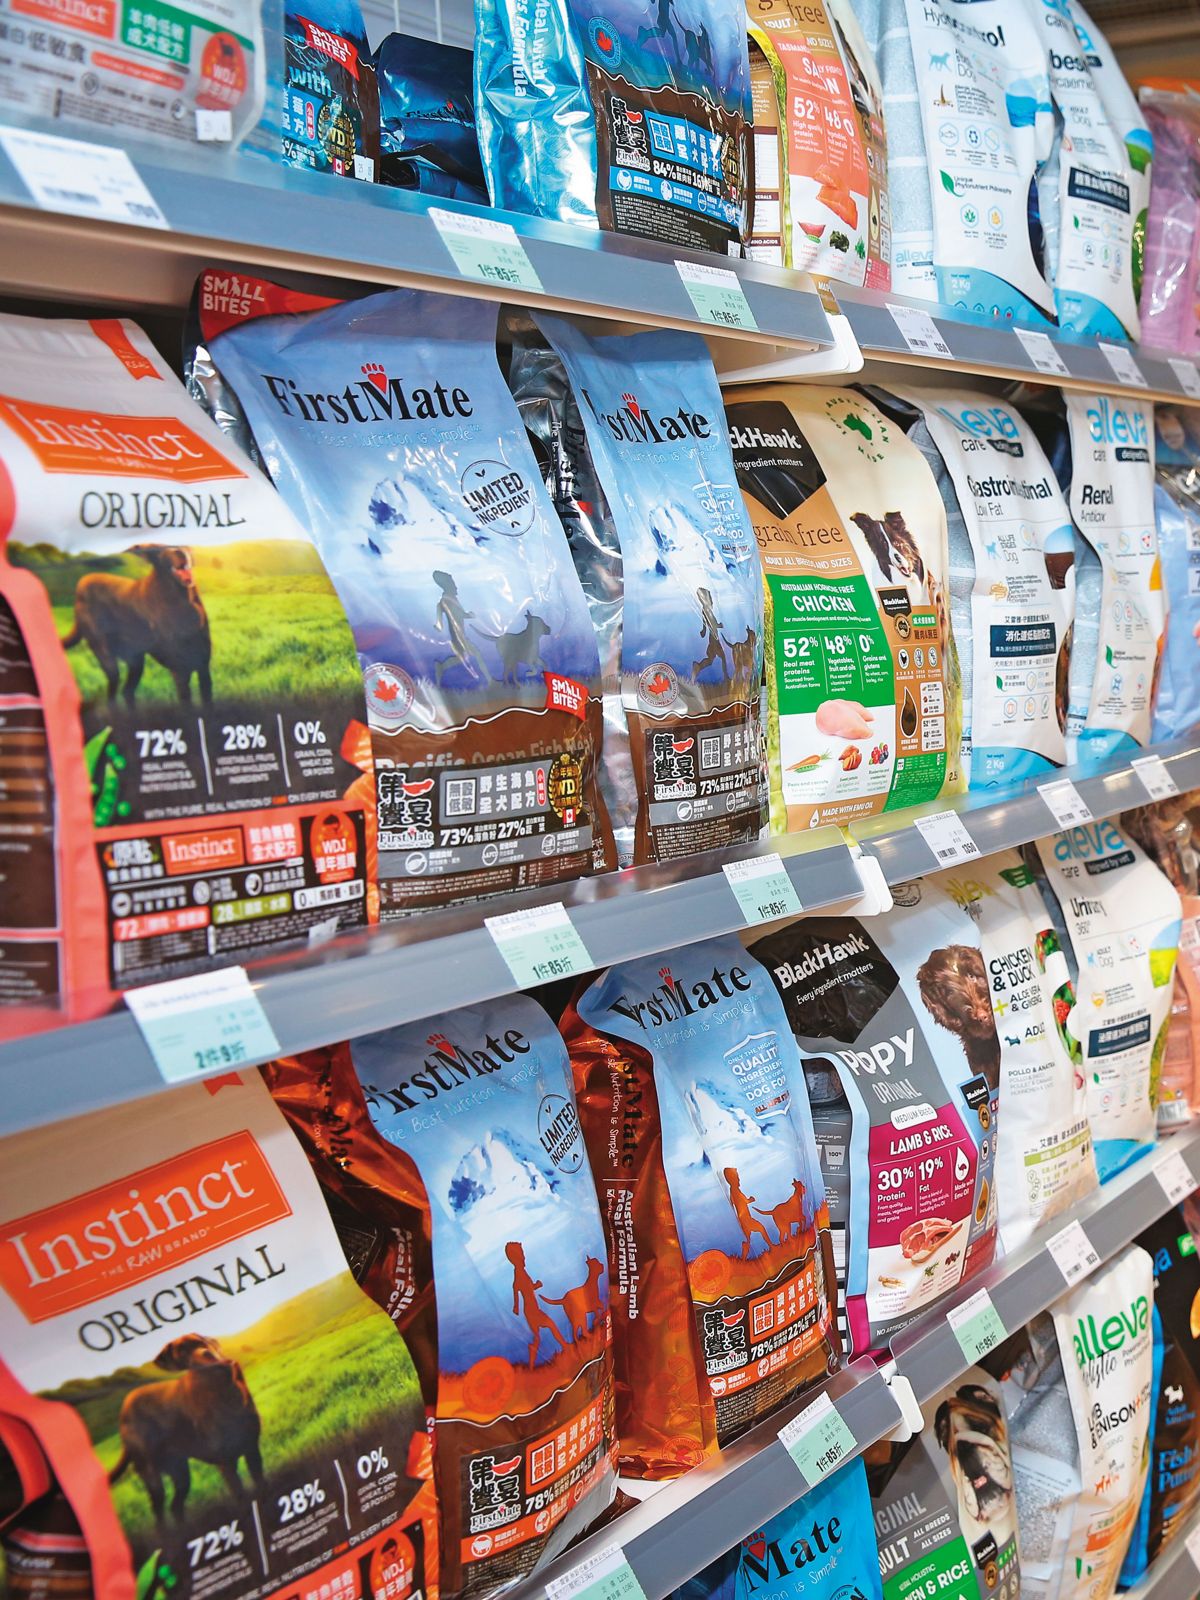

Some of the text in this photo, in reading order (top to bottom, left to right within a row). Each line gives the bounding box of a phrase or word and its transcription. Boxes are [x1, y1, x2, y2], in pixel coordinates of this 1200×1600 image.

[308, 24, 352, 57] SMALL
[312, 33, 348, 63] BITES
[288, 65, 333, 98] with
[652, 160, 676, 179] 84%
[203, 274, 266, 303] SMALL
[203, 293, 251, 317] BITES
[261, 374, 474, 424] FirstMate
[8, 404, 204, 462] Instinct
[731, 426, 802, 450] ckHawk
[962, 438, 987, 452] care
[736, 458, 777, 471] ingredient
[463, 472, 525, 514] LIMITED
[1081, 484, 1114, 506] Renal
[79, 491, 247, 530] ORIGINAL
[476, 489, 534, 527] INGREDIENT
[989, 501, 1003, 516] Fat
[753, 522, 844, 548] grain free
[765, 556, 853, 568] ADULT SIZES
[781, 583, 856, 595] AUSTRALIAN FREE
[791, 594, 856, 613] CHICKEN
[783, 634, 875, 658] 52% 48% 0%
[783, 659, 815, 668] Real meat
[783, 667, 810, 677] proteins
[828, 657, 855, 666] Vegetables,
[552, 678, 583, 700] SMALL
[553, 692, 578, 711] BITES
[136, 720, 327, 758] 72% 28% 0%
[993, 758, 1005, 770] Kg
[655, 782, 696, 797] FirstMate
[700, 779, 720, 797] 73%
[821, 804, 854, 818] MADE WITH
[379, 829, 433, 844] FirstMate
[440, 827, 474, 847] 73%
[497, 819, 525, 840] 27%
[168, 834, 236, 863] Instinct
[321, 838, 347, 854] WDJ
[757, 899, 789, 919] 1件85折
[532, 956, 574, 980] 1件85折
[773, 933, 870, 990] BlackHawk
[989, 946, 1035, 976] CHICKEN
[1099, 955, 1115, 968] Dog
[796, 961, 874, 1006] Every ingredient matters
[992, 965, 1036, 993] & DUCK
[727, 1049, 757, 1064] ONLY THE
[1008, 1067, 1032, 1077] POLLO
[609, 1070, 622, 1125] Nutrition is
[745, 1083, 770, 1101] DOG
[411, 1085, 496, 1135] Best Nutrition
[755, 1104, 768, 1114] ALL
[894, 1111, 919, 1124] MEDIUM
[540, 1102, 576, 1154] LIMITED
[889, 1124, 954, 1156] LAMB & RICE
[877, 1156, 944, 1191] 30% 19%
[877, 1183, 930, 1203] Protein Fat
[954, 1182, 966, 1191] Made
[954, 1191, 964, 1200] Emu
[889, 1202, 904, 1211] quality
[892, 1205, 913, 1216] vegetables
[8, 1158, 256, 1288] Instinct
[887, 1215, 900, 1223] grains
[613, 1188, 629, 1295] Meal Formula
[101, 1228, 211, 1280] THE RAW BRAND
[623, 1188, 640, 1320] Australian Lamb
[79, 1244, 287, 1352] ORIGINAL
[787, 1319, 805, 1340] 22%
[1072, 1295, 1150, 1370] alleva
[706, 1351, 748, 1371] FirstMate
[750, 1339, 774, 1361] 78%
[357, 1446, 389, 1479] 0%
[815, 1441, 845, 1473] 1件85折
[569, 1462, 588, 1486] 22%
[277, 1479, 326, 1523] 28%
[525, 1491, 555, 1516] 78%
[470, 1503, 521, 1528] FirstMate
[913, 1513, 951, 1539] ALL BREEDS
[187, 1519, 244, 1567] 72%
[921, 1527, 952, 1550] ALL SIZES
[281, 1554, 322, 1582] NUTRITION
[381, 1558, 405, 1583] WDJ
[910, 1563, 937, 1584] HOLISTIC
[925, 1580, 937, 1596] &
[936, 1559, 970, 1590] RICE
[794, 1581, 807, 1593] is
